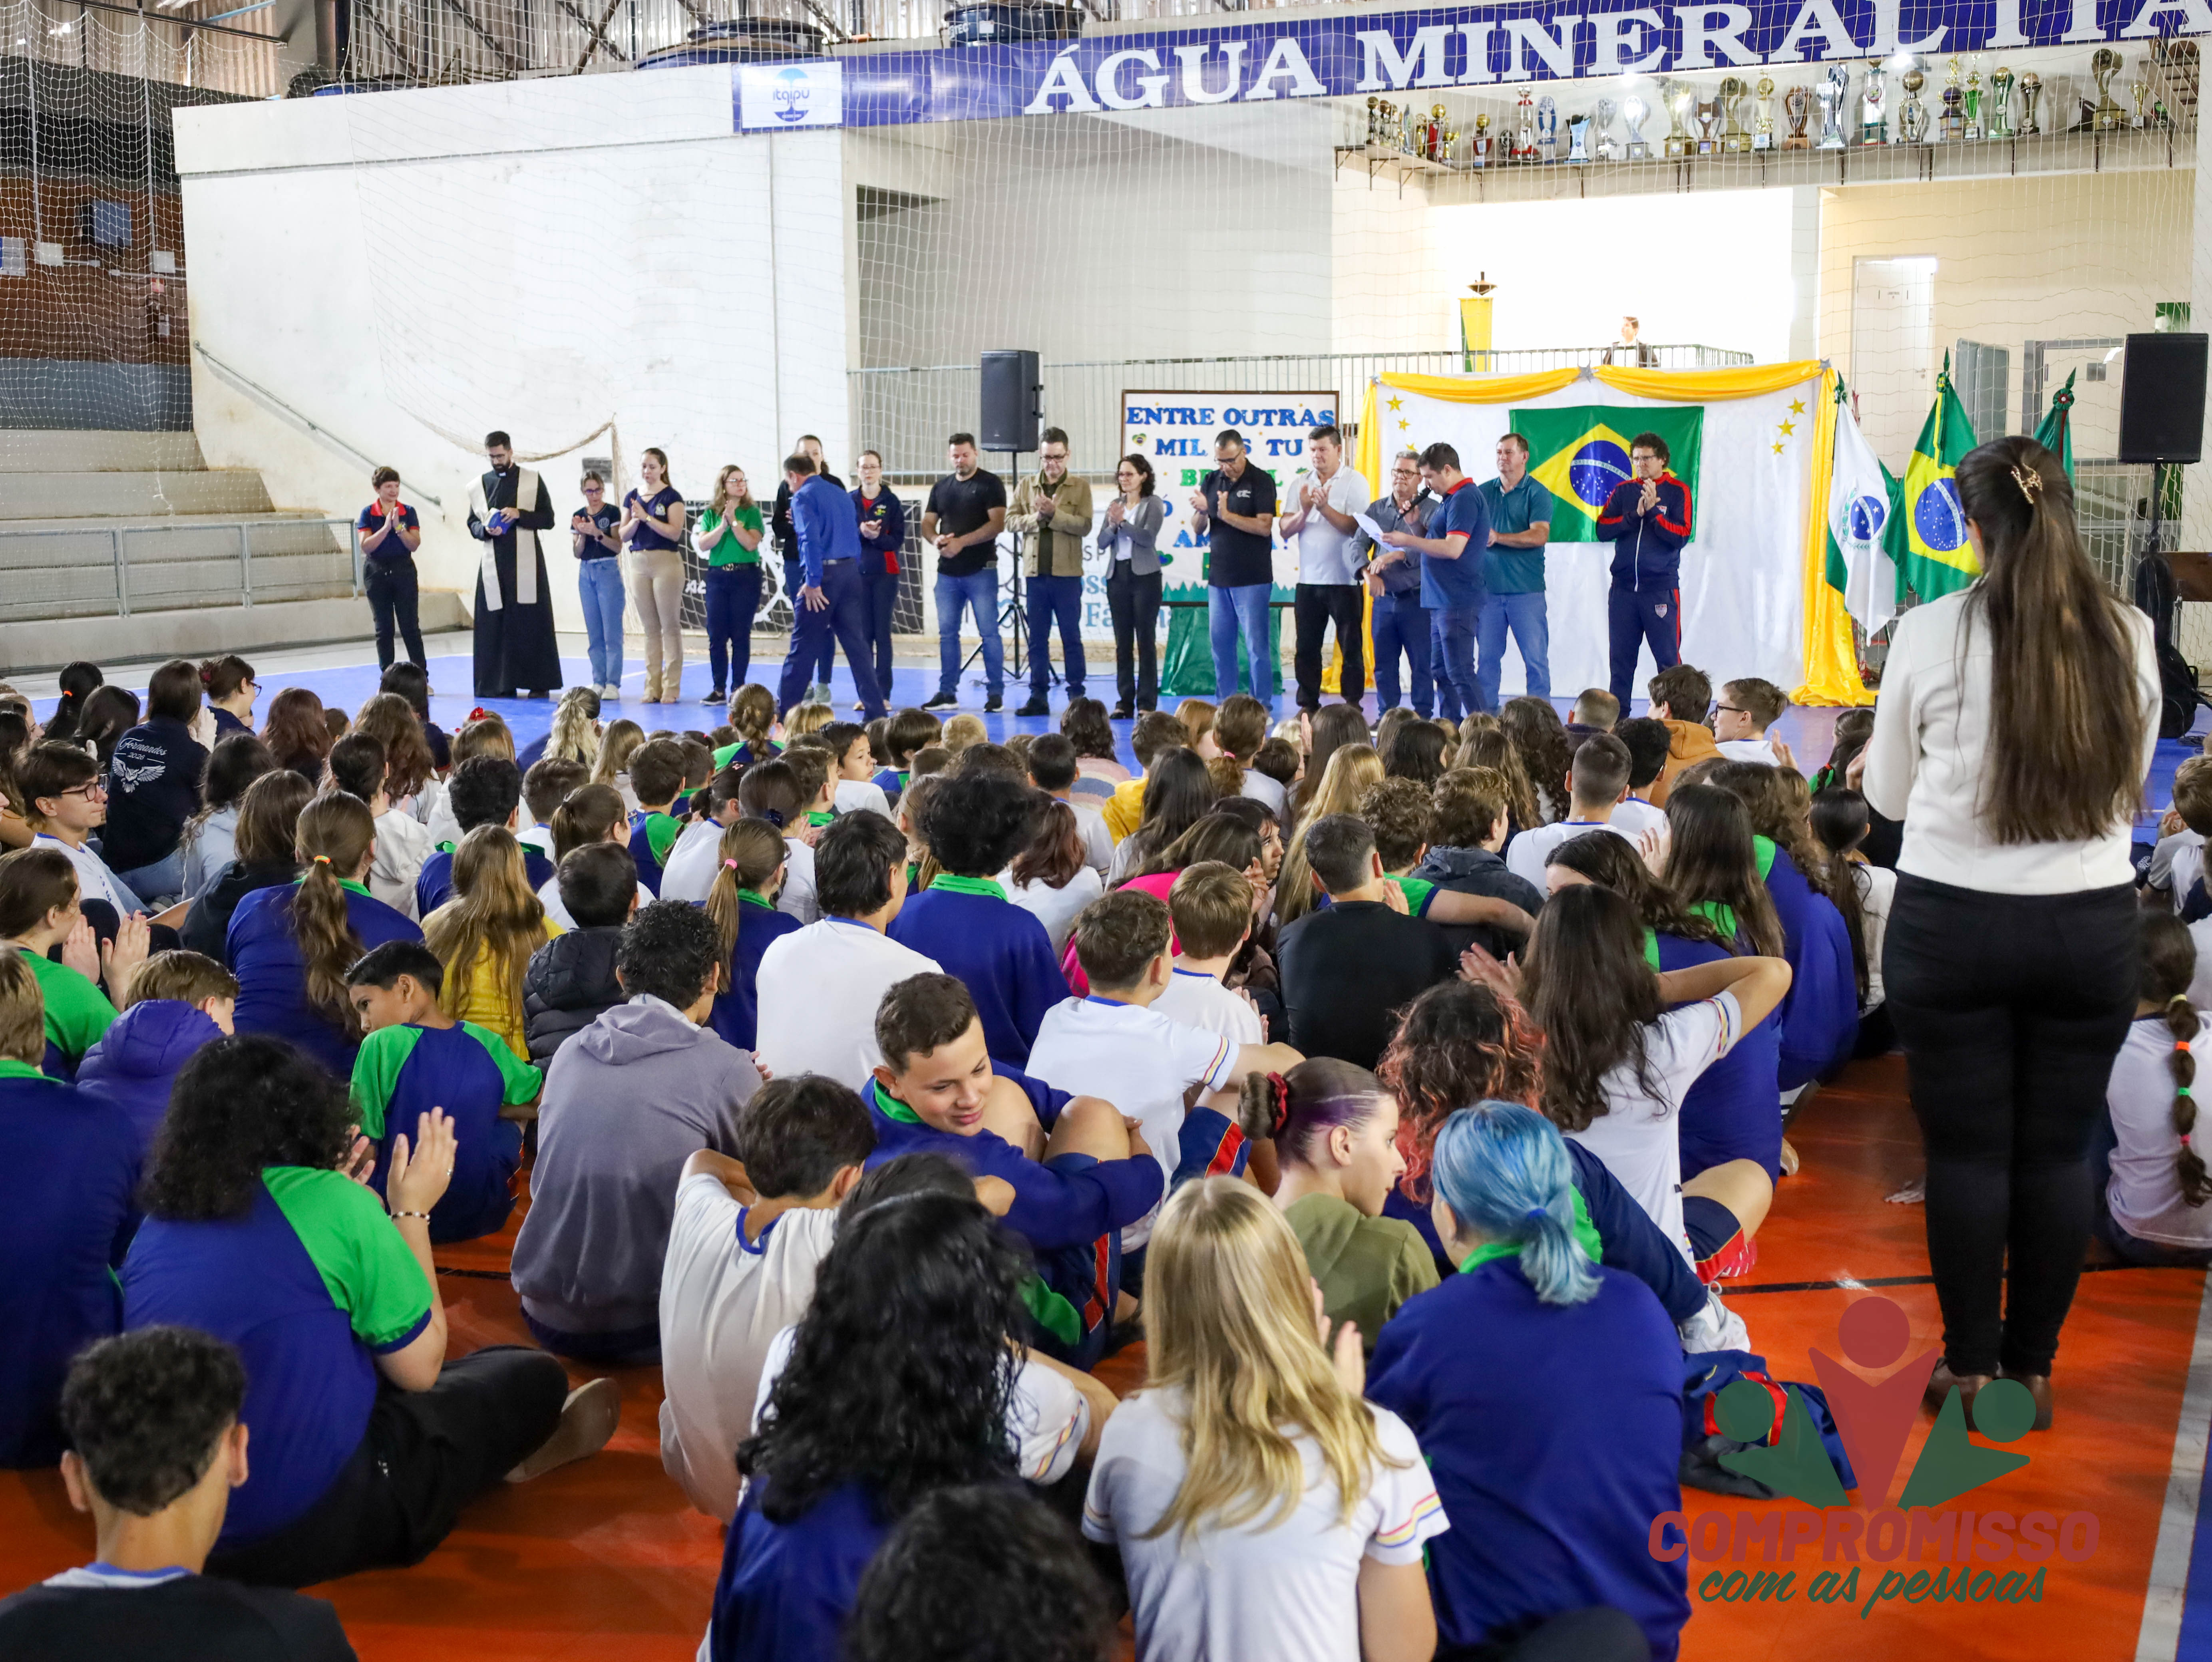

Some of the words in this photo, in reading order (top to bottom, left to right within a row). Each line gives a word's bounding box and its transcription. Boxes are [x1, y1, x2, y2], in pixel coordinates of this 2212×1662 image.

[1024, 43, 1327, 114] ÁGUA
[1356, 0, 1949, 91] MINERAL
[773, 88, 810, 105] itaipu
[1126, 407, 1215, 425] ENTRE
[1223, 408, 1335, 427] OUTRAS
[1155, 439, 1208, 456] MIL
[1266, 439, 1303, 456] TU
[119, 738, 168, 755] Formandos
